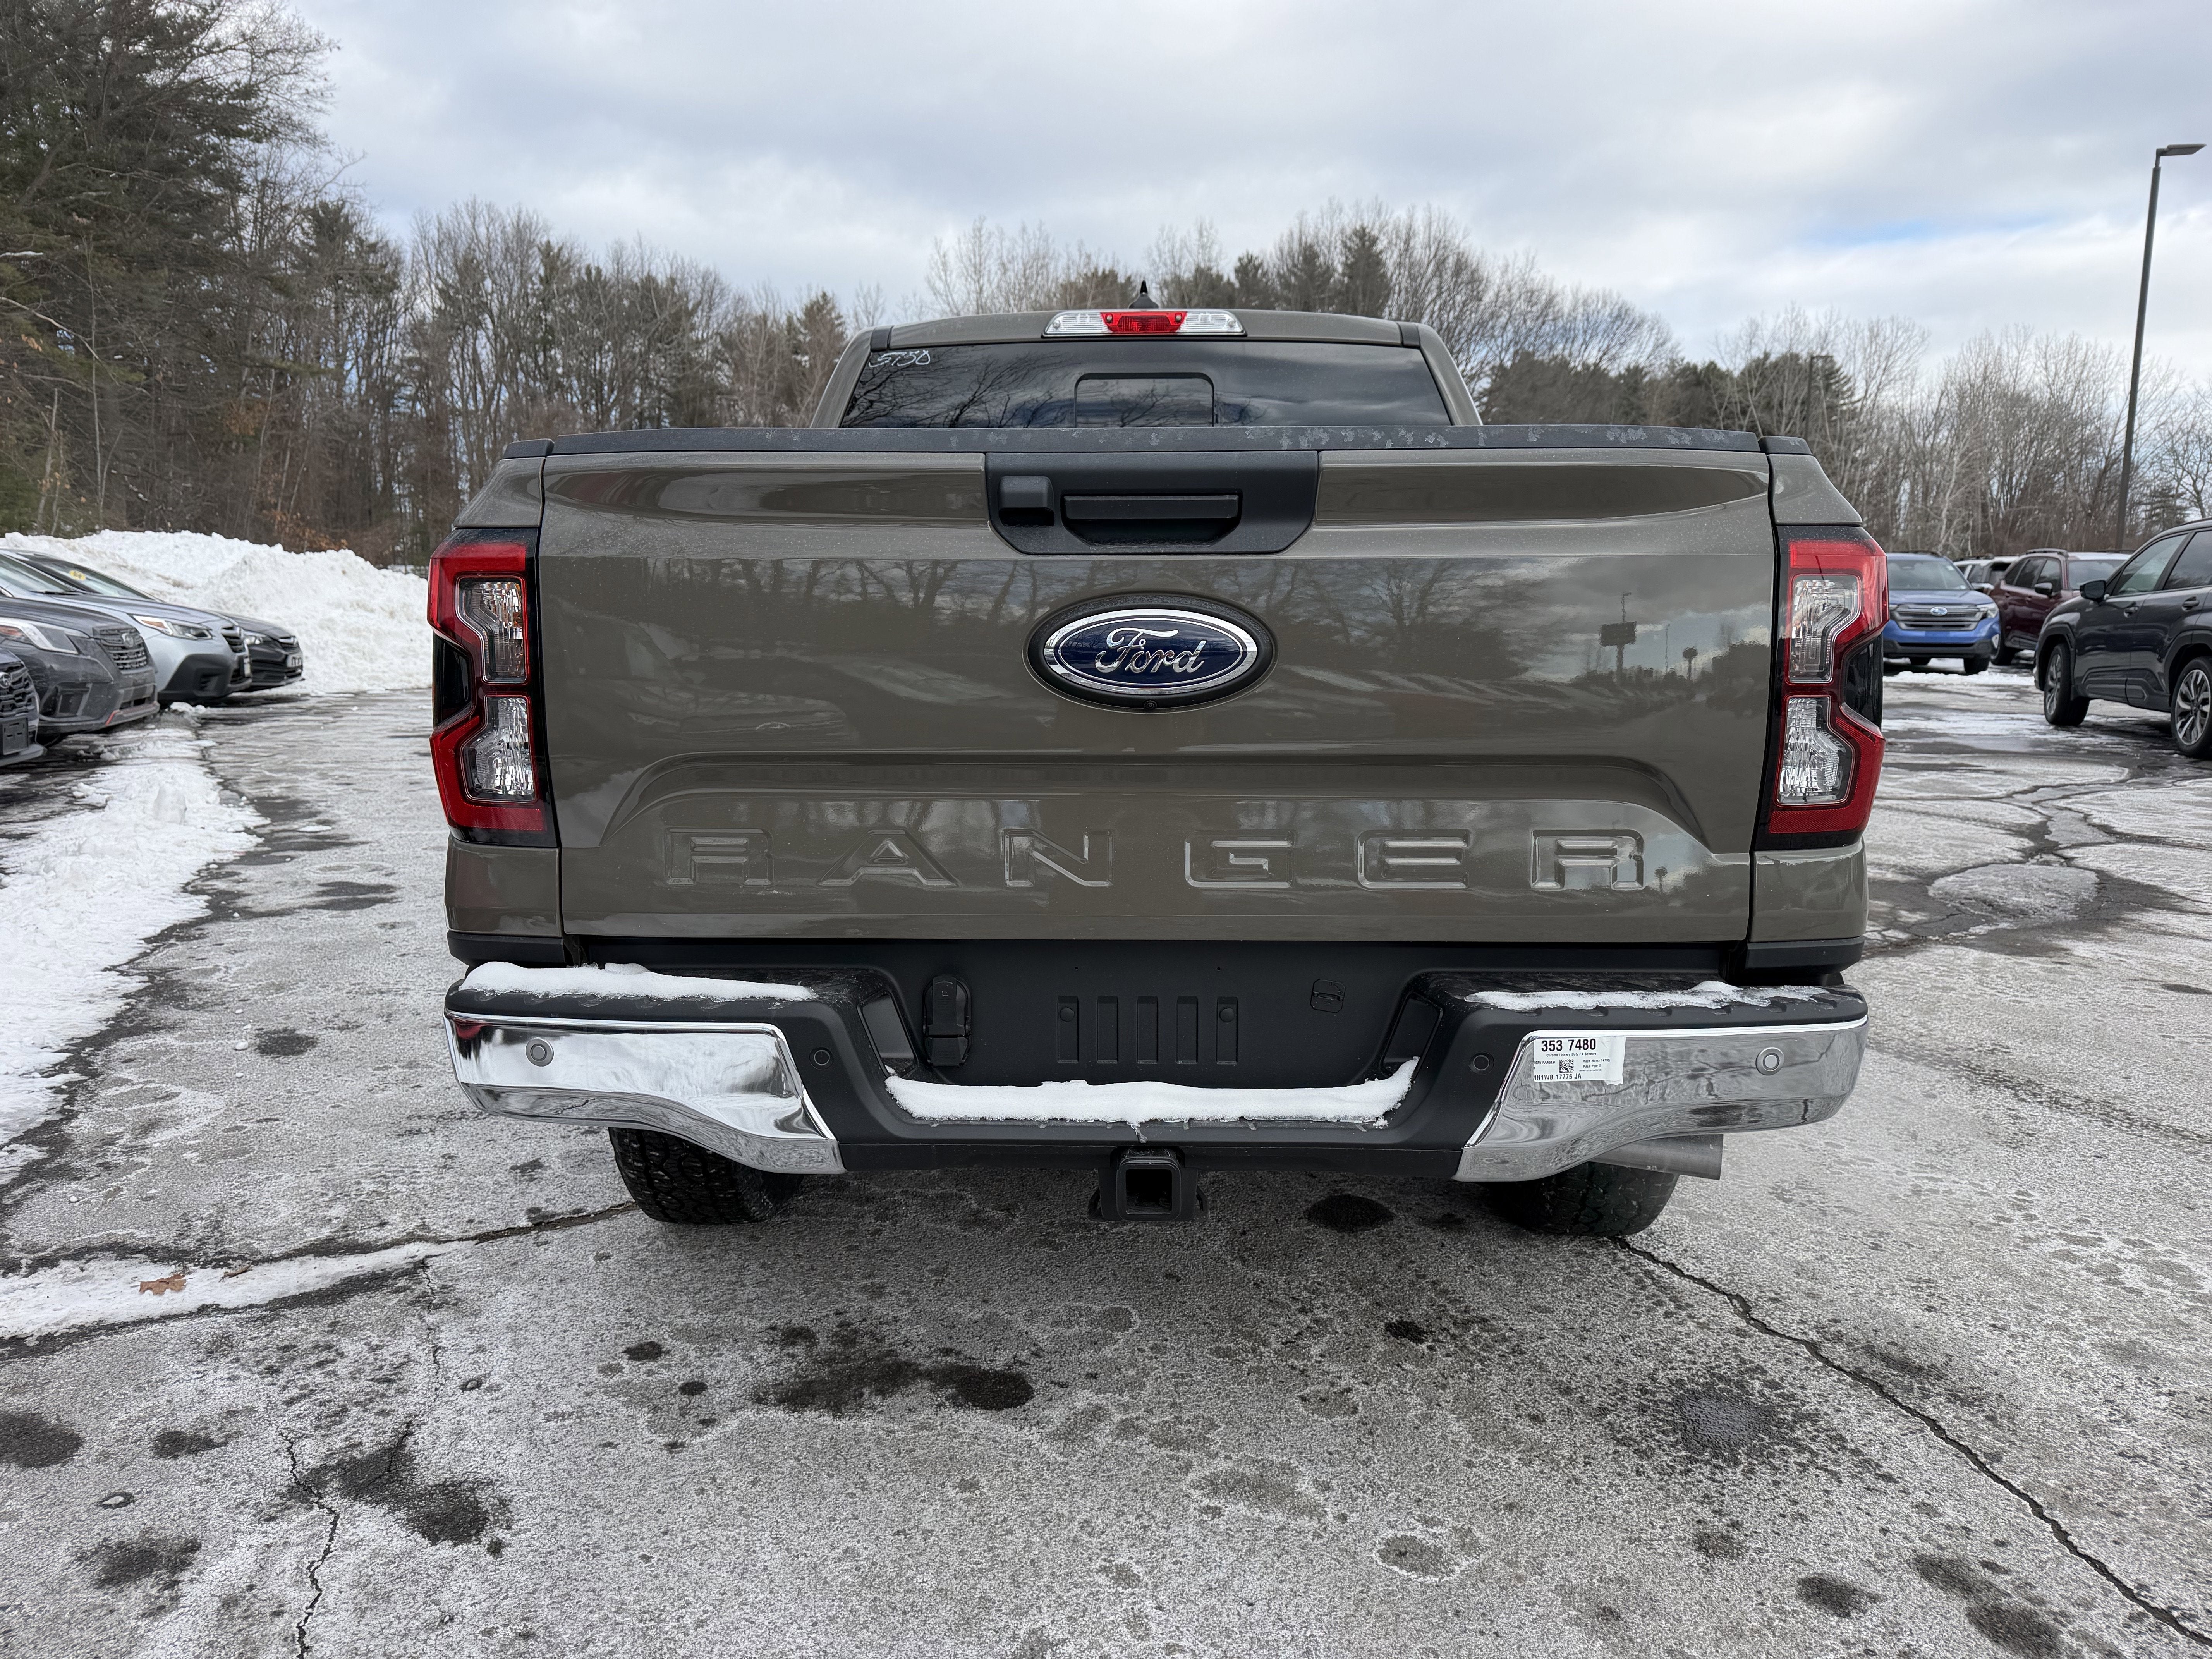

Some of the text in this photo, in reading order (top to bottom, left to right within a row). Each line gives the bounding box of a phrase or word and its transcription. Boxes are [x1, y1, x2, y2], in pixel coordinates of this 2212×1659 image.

[1095, 627, 1207, 673] Ford
[663, 827, 1645, 890] RANGER
[1541, 1038, 1596, 1052] 353 7480
